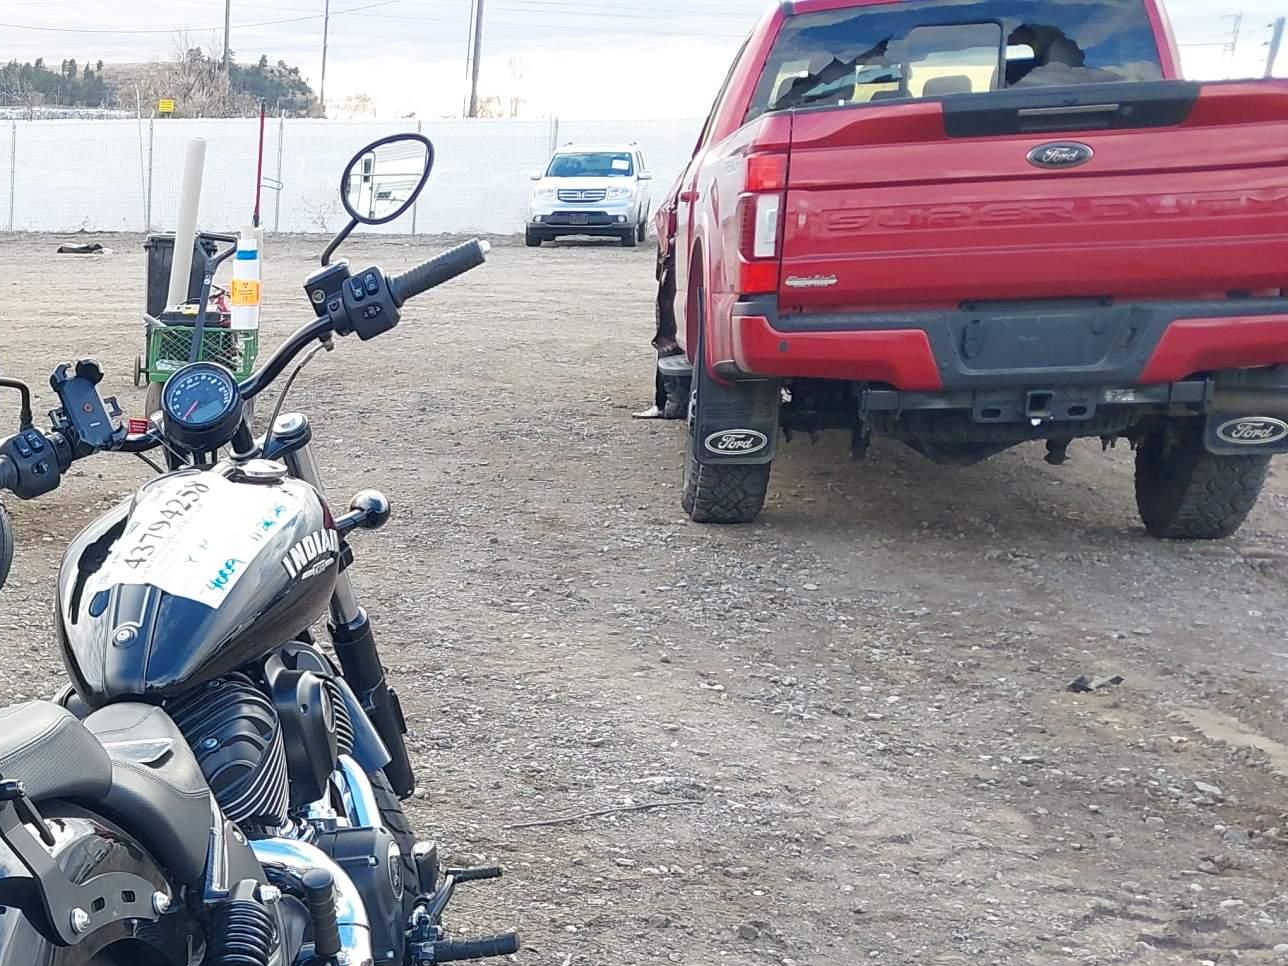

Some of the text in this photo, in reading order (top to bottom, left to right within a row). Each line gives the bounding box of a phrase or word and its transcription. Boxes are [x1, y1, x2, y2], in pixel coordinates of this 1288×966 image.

[1042, 147, 1079, 163] Ford
[823, 199, 1074, 232] SUPER
[1231, 422, 1274, 438] Ford
[717, 434, 754, 449] Ford
[124, 480, 210, 569] 43794258
